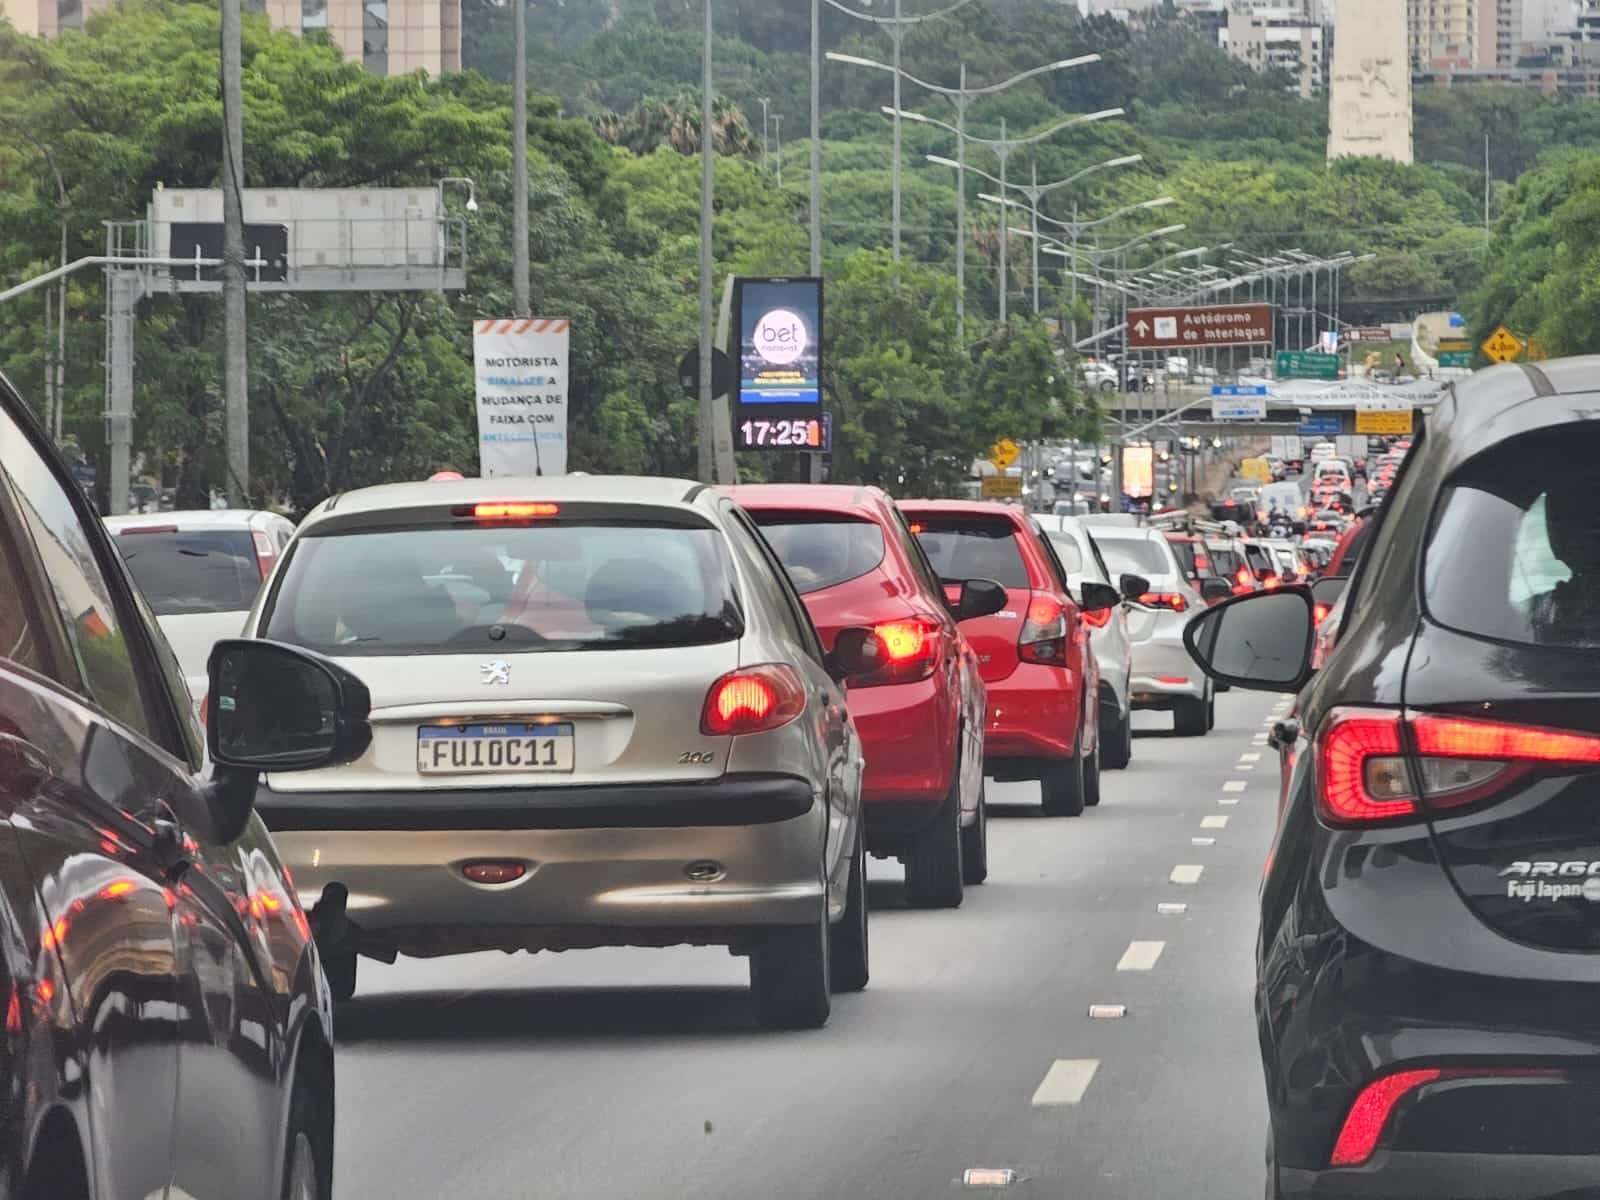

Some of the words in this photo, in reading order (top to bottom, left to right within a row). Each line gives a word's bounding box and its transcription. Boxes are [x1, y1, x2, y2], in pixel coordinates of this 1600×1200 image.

[762, 323, 798, 342] bet
[1183, 329, 1197, 339] de
[1204, 327, 1266, 340] Interlagos
[485, 357, 559, 368] MOTORISTA
[488, 376, 544, 386] SINALIZE
[547, 377, 556, 385] A
[482, 395, 542, 406] MUDANÇA
[546, 395, 562, 404] DE
[490, 415, 525, 424] FAIXA
[528, 414, 554, 424] COM
[741, 421, 807, 445] 17:25
[679, 751, 713, 764] 206
[1508, 880, 1536, 902] Fuji
[1537, 880, 1583, 902] Japan
